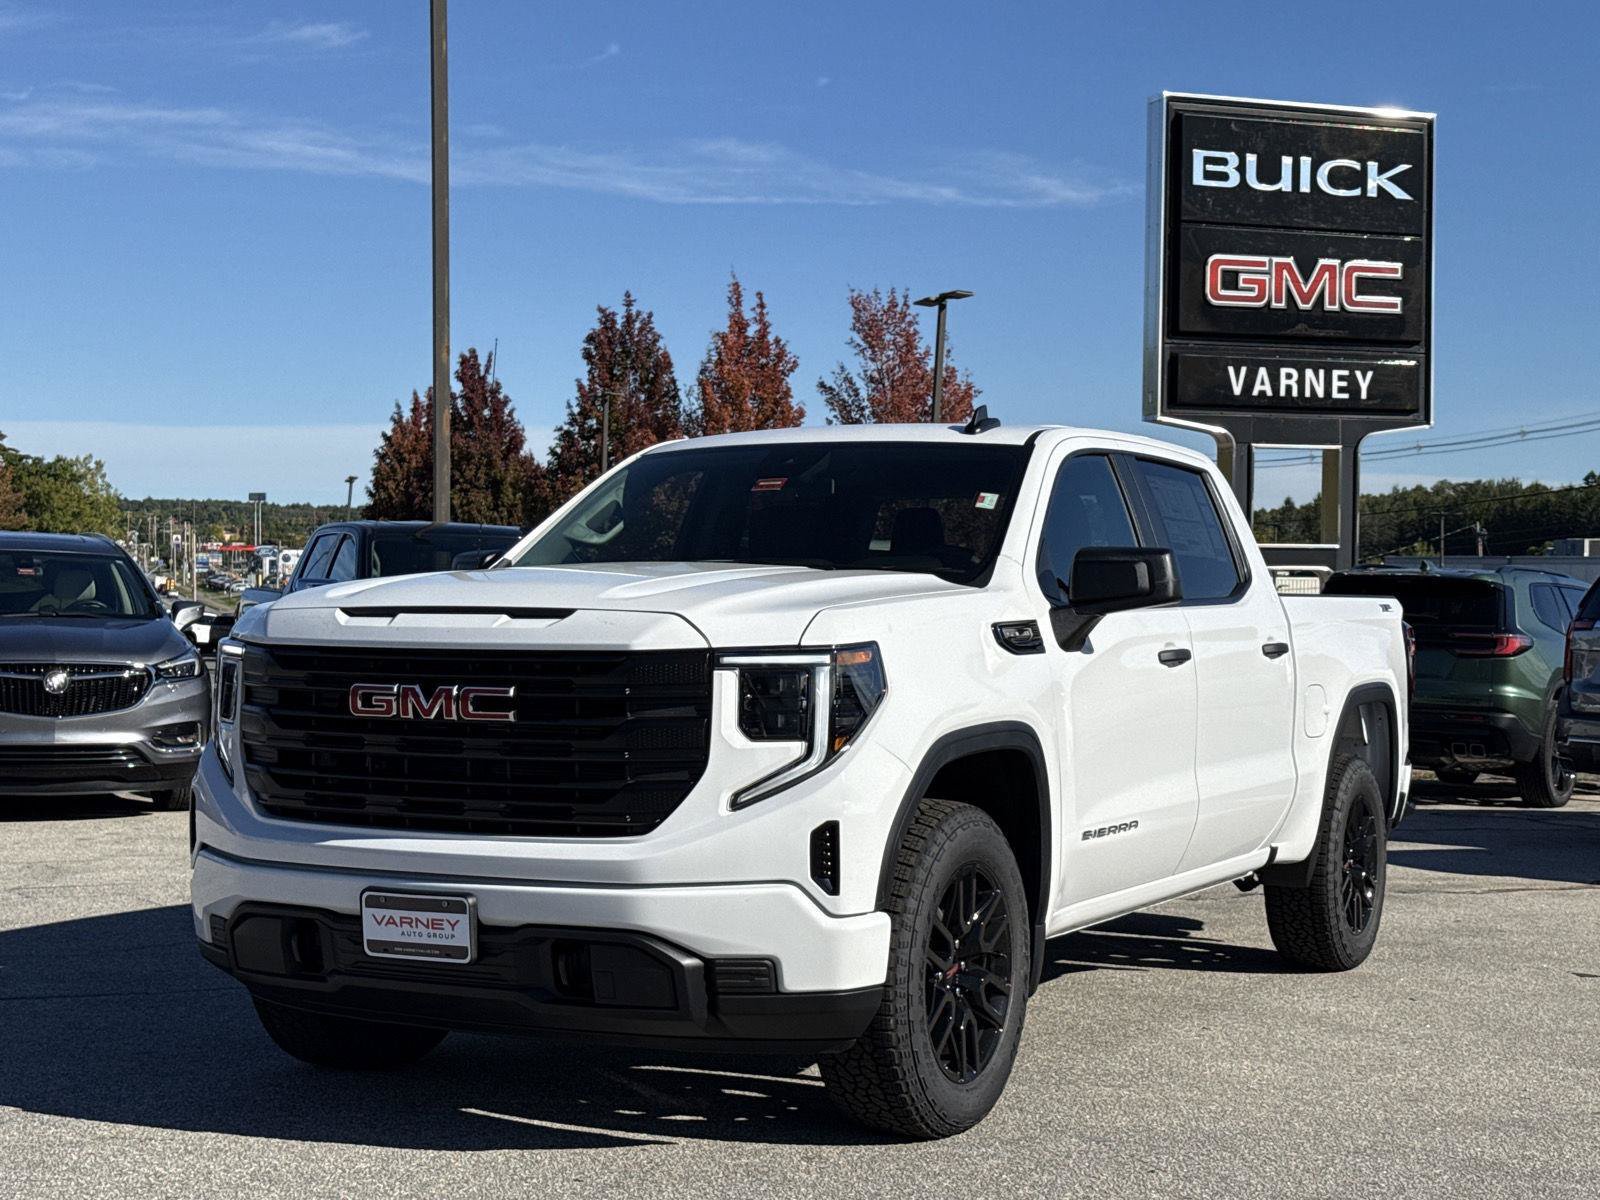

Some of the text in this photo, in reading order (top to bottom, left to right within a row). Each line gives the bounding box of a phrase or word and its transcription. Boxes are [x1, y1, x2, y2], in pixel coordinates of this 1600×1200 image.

[1192, 148, 1414, 200] BUICK
[1205, 253, 1403, 314] GMC
[1227, 365, 1374, 400] VARNEY
[350, 683, 516, 722] GMC
[1081, 820, 1139, 841] SIERRA
[371, 913, 461, 932] VARNEY
[400, 930, 456, 940] AUTO GROUP
